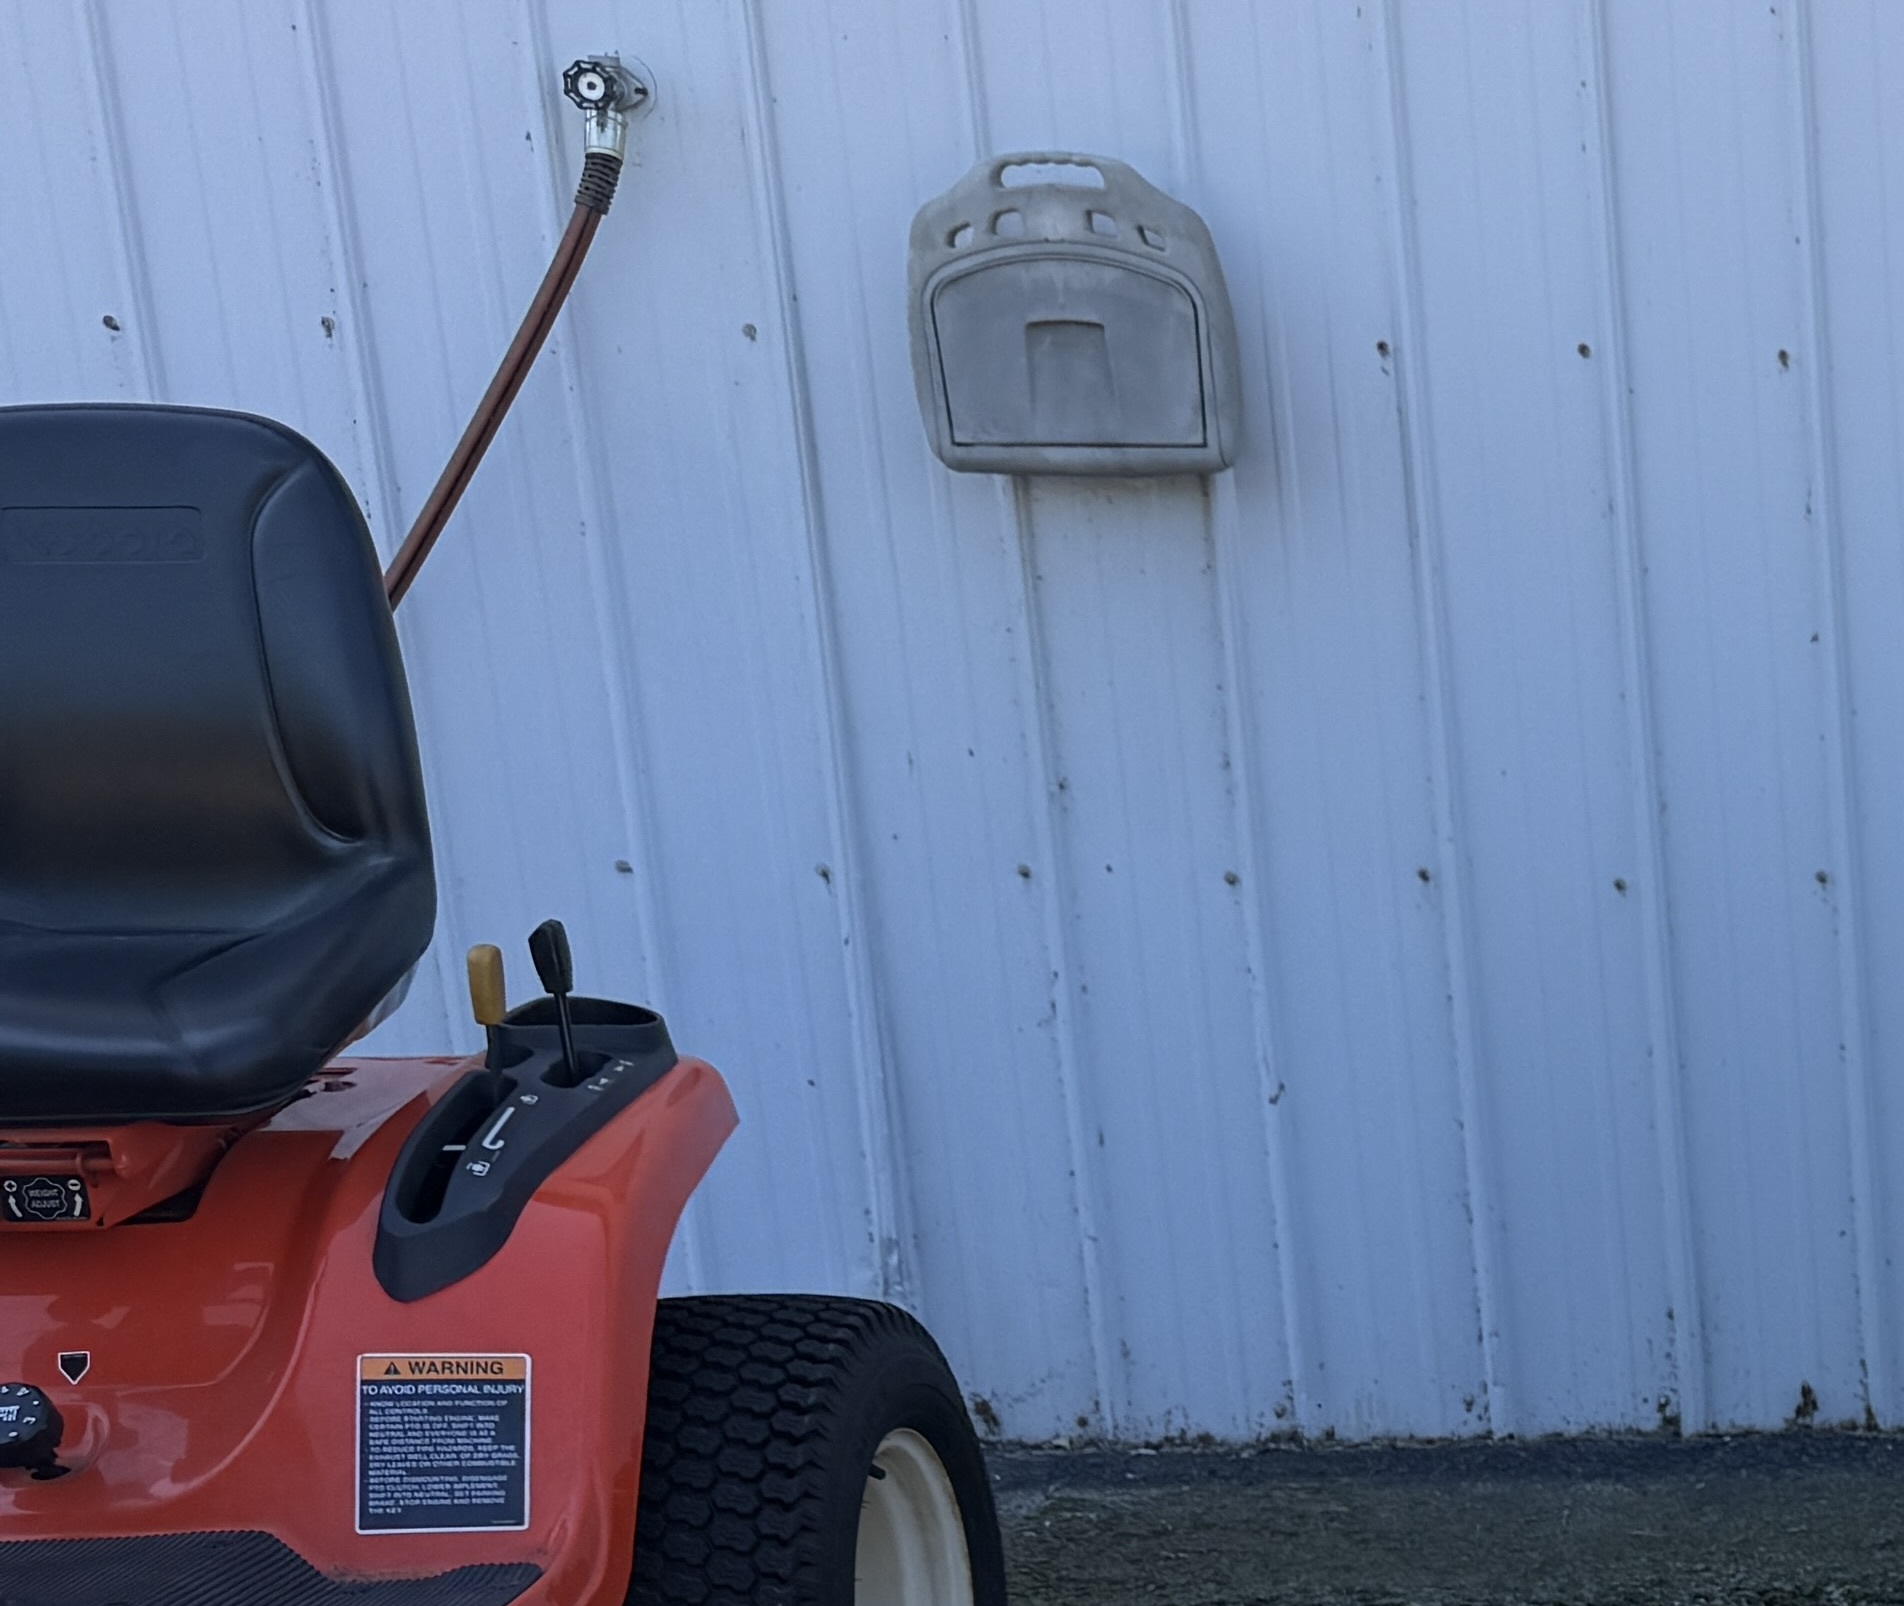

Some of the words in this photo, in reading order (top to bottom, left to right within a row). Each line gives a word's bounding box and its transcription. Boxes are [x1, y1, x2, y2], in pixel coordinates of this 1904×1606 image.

[407, 1360, 504, 1376] WARNING
[362, 1385, 378, 1395] TO
[379, 1384, 416, 1395] AVOID
[417, 1383, 481, 1395] PERSONAL
[483, 1382, 524, 1394] INJURY
